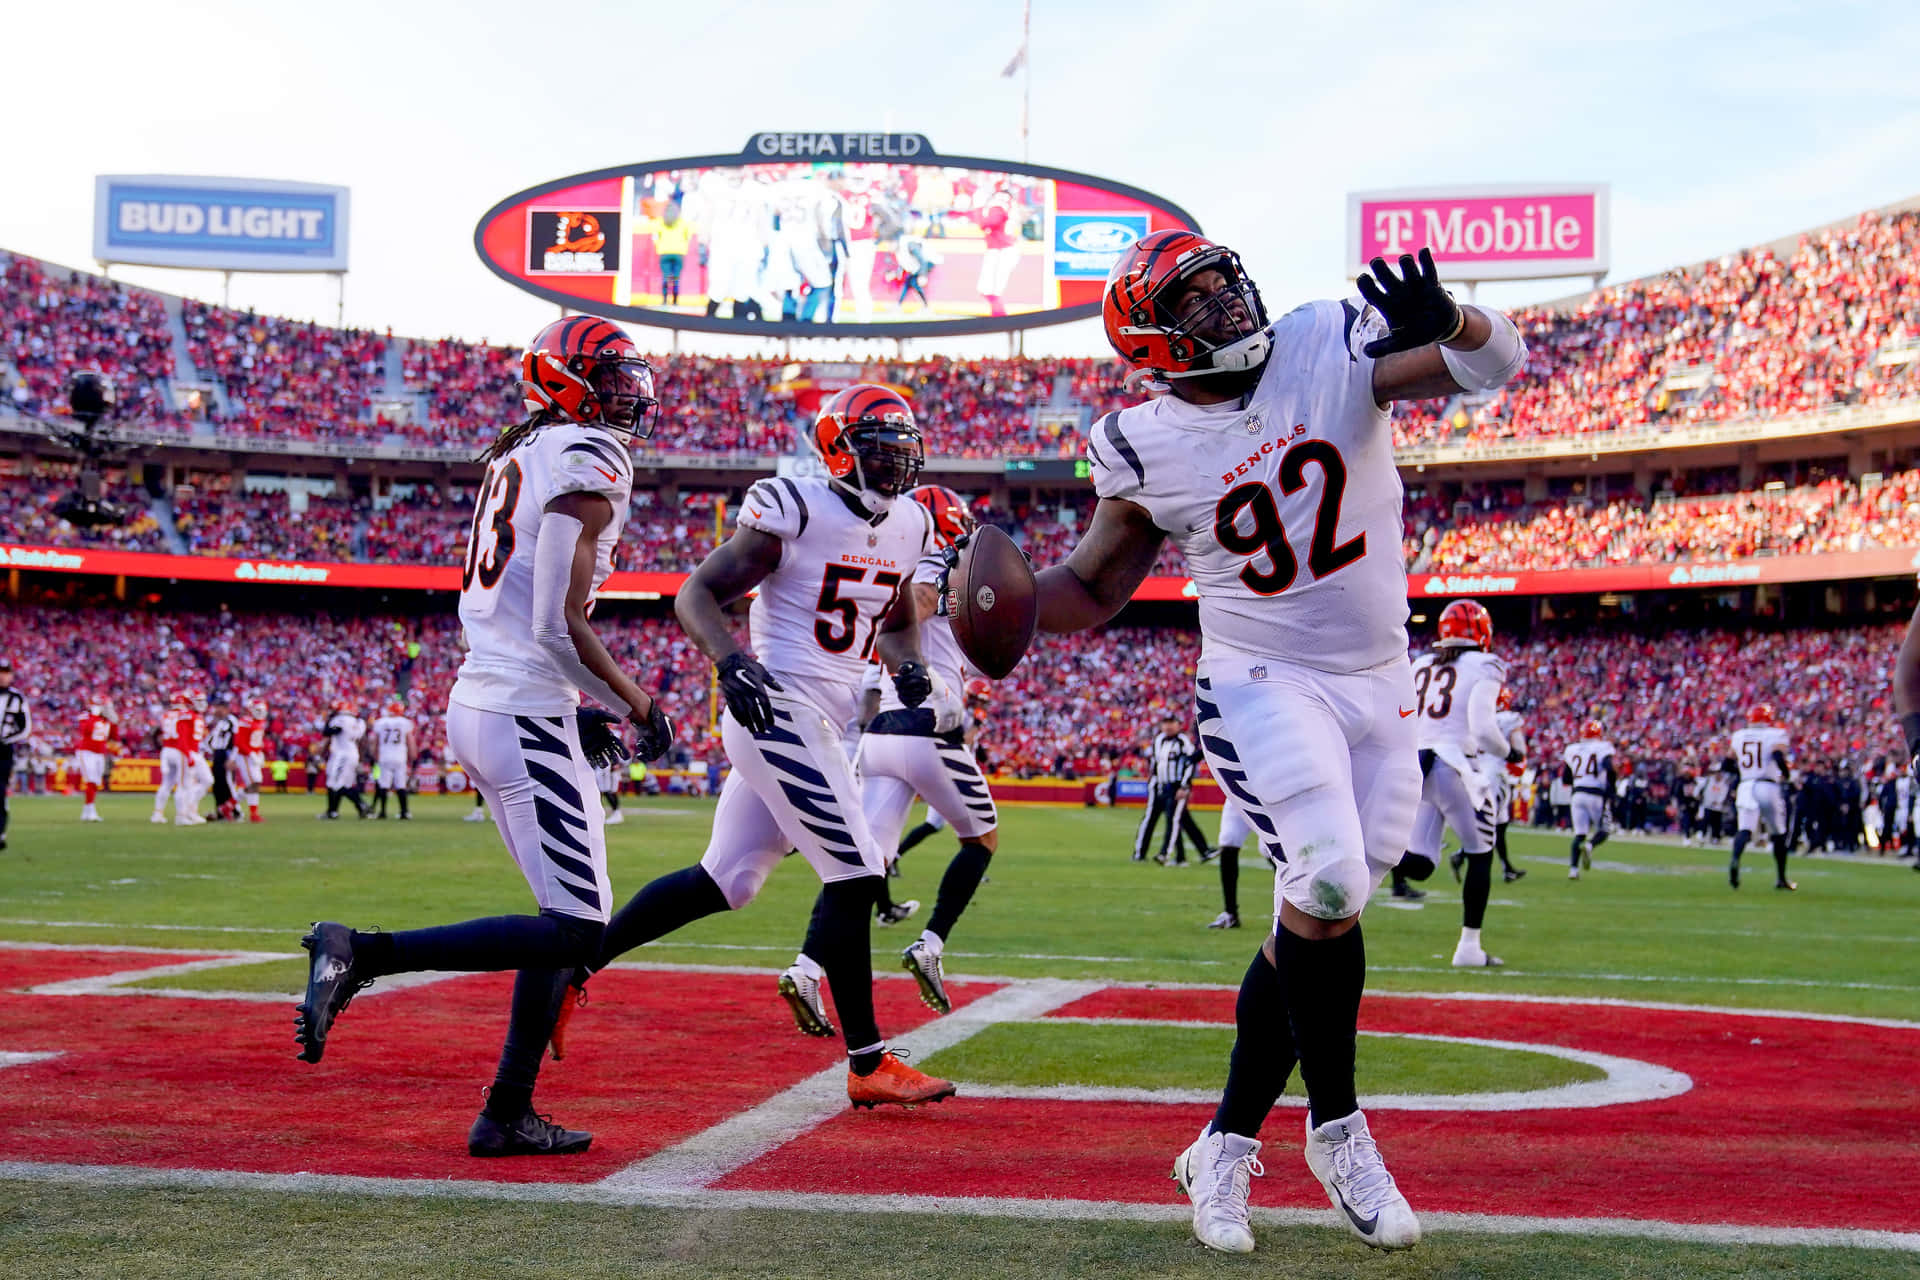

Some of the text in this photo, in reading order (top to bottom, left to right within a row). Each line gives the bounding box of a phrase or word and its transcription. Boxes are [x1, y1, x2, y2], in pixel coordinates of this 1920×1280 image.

[757, 133, 921, 156] GEHA FIELD
[119, 201, 323, 240] BUD LIGHT
[1222, 424, 1306, 485] BENGALS
[1214, 439, 1366, 596] 92
[841, 553, 897, 569] BENGALS
[814, 562, 901, 659] 57
[1573, 753, 1598, 778] 24
[1742, 742, 1762, 769] 51
